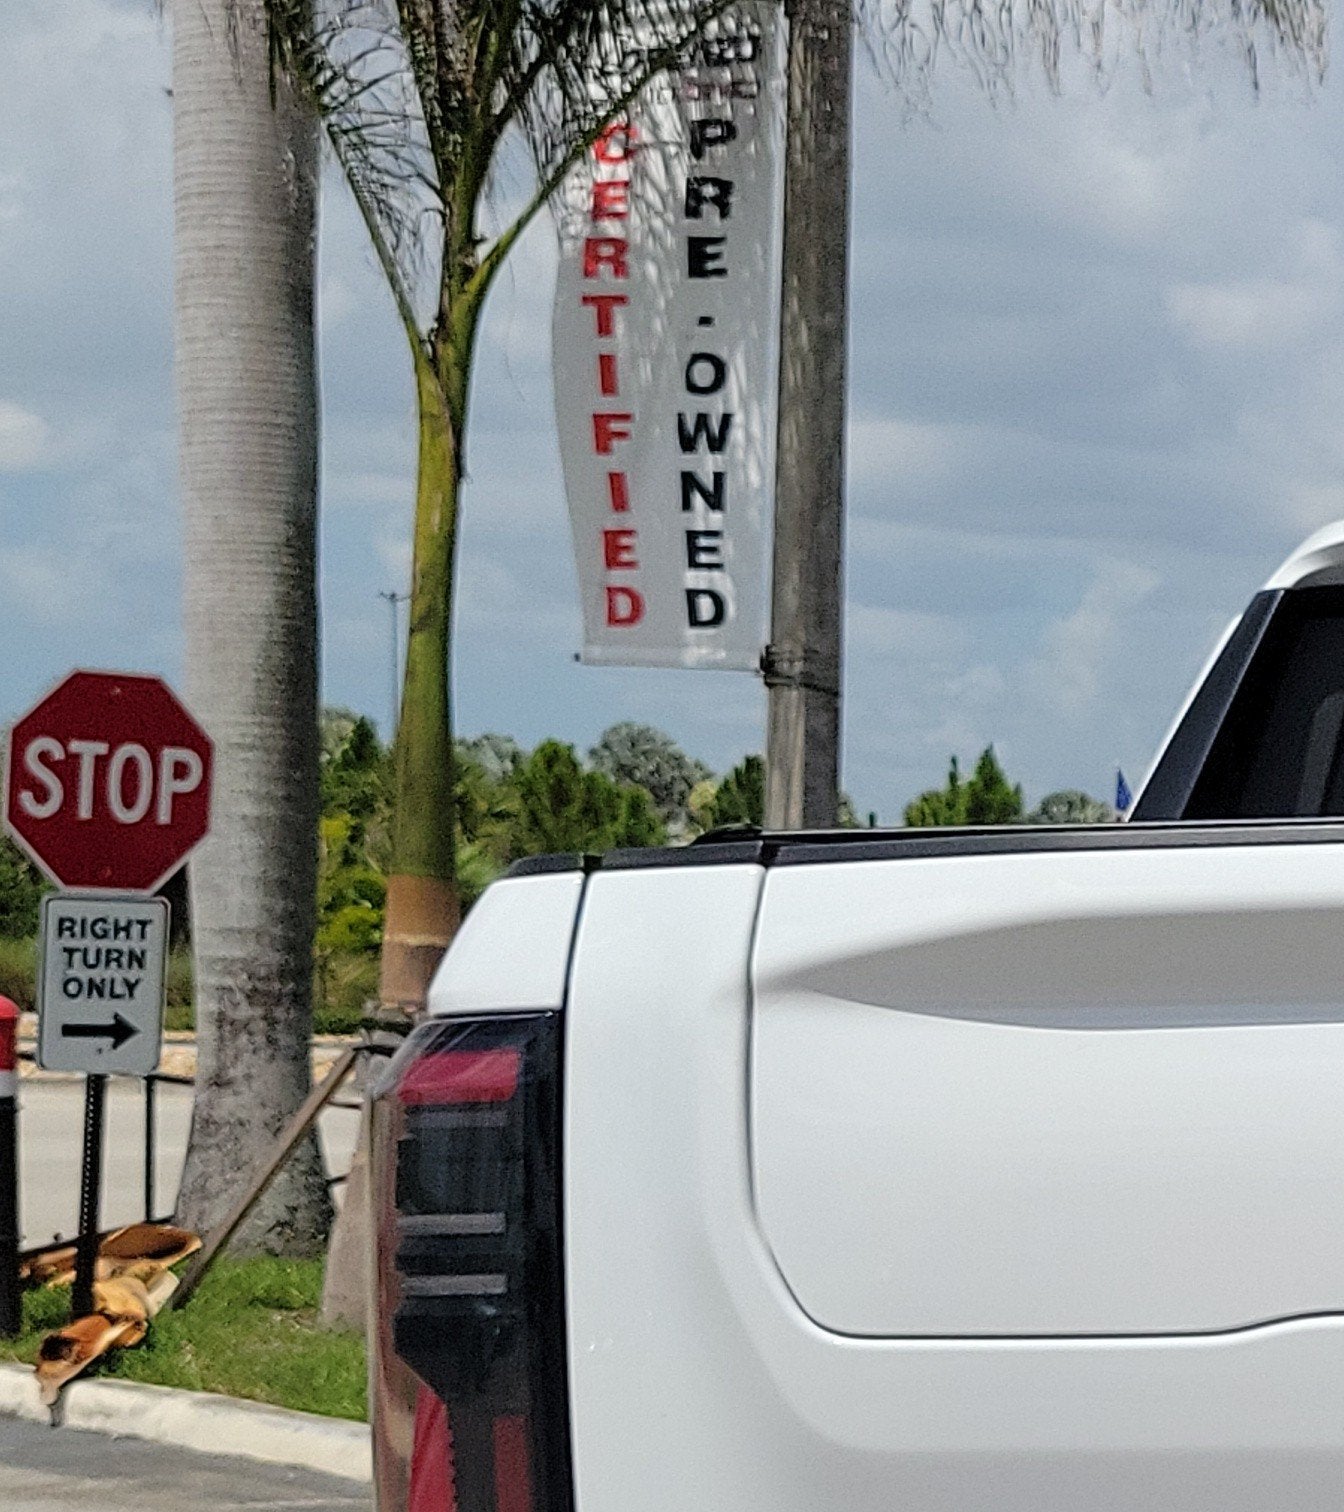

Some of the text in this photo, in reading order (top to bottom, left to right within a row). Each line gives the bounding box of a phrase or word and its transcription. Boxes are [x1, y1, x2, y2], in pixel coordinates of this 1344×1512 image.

[582, 122, 645, 630] CERTIFIED
[20, 737, 203, 825] STOP
[57, 917, 153, 941] RIGHT
[62, 946, 147, 970] TURN
[62, 976, 142, 1000] ONLY
